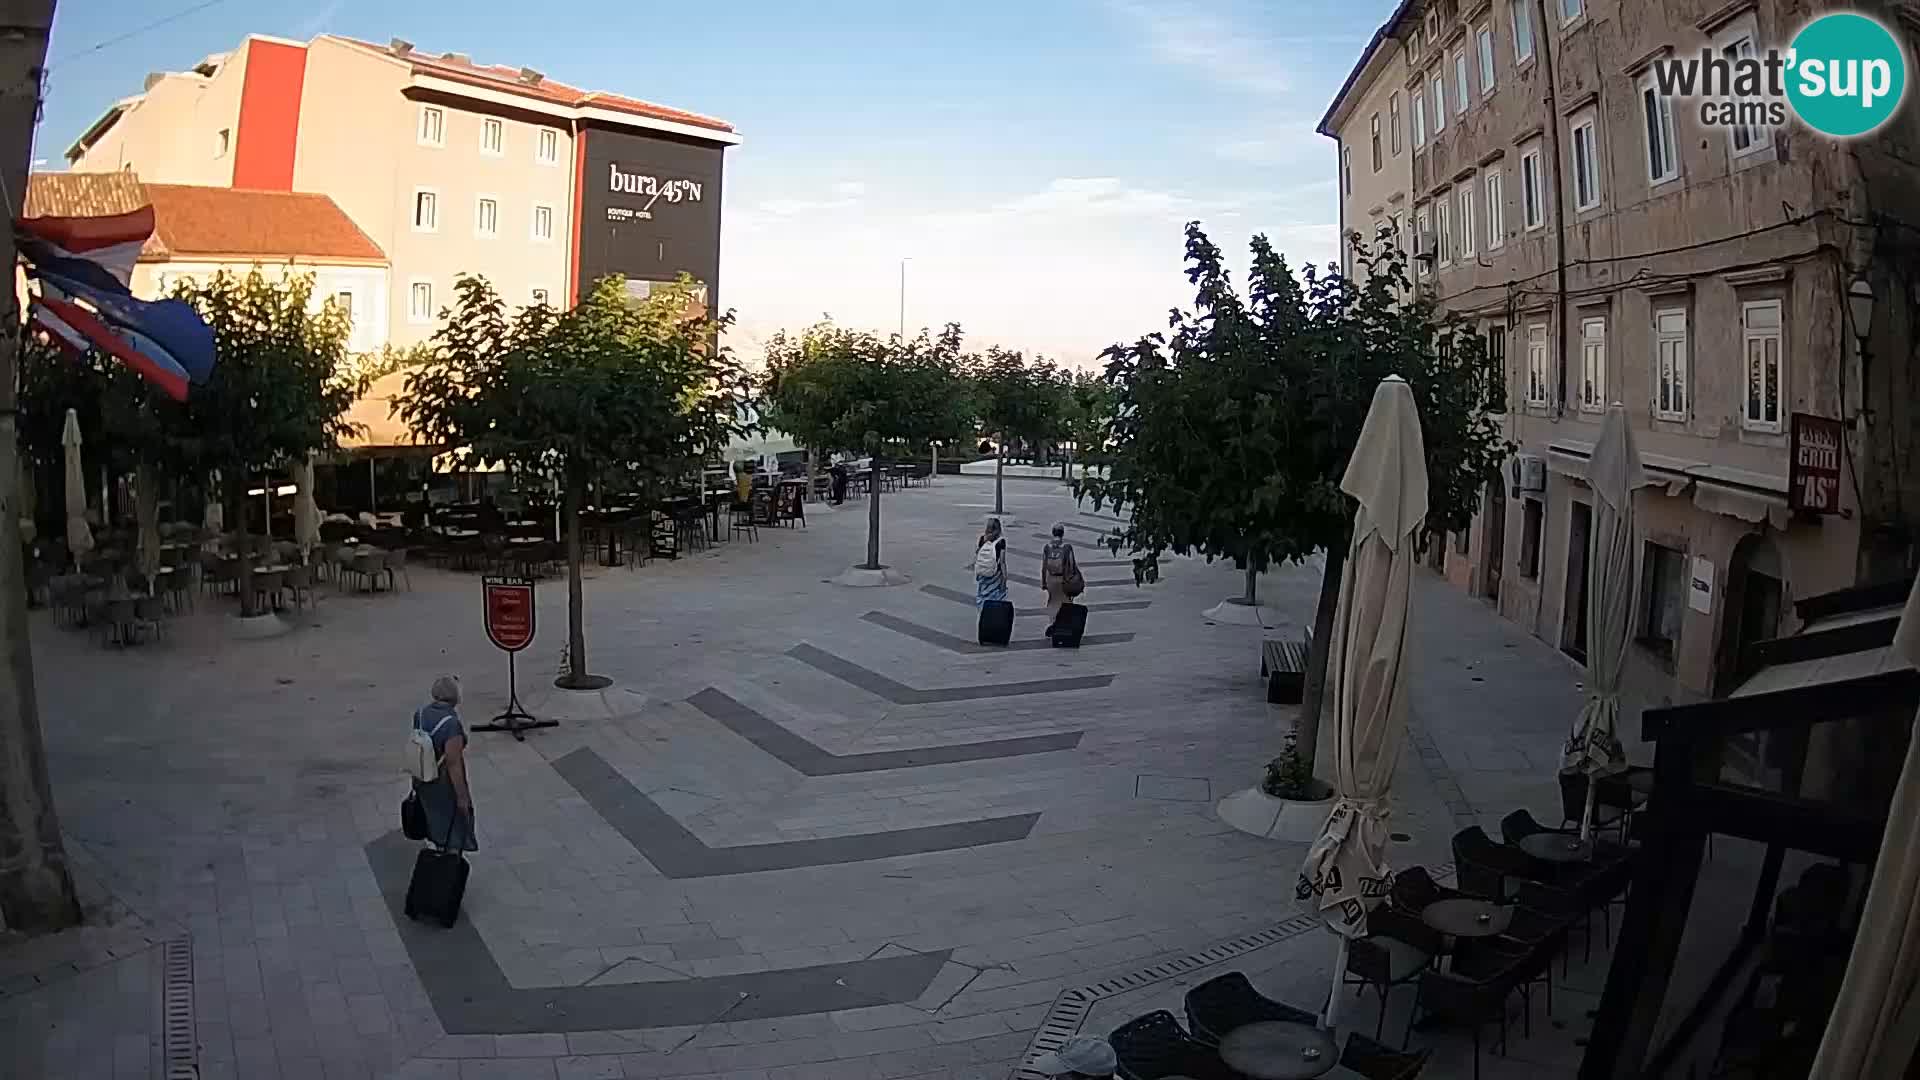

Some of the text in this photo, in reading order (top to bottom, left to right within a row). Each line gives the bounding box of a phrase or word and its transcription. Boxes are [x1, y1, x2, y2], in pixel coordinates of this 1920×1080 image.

[610, 163, 657, 195] bura
[485, 577, 522, 585] WINE BAR
